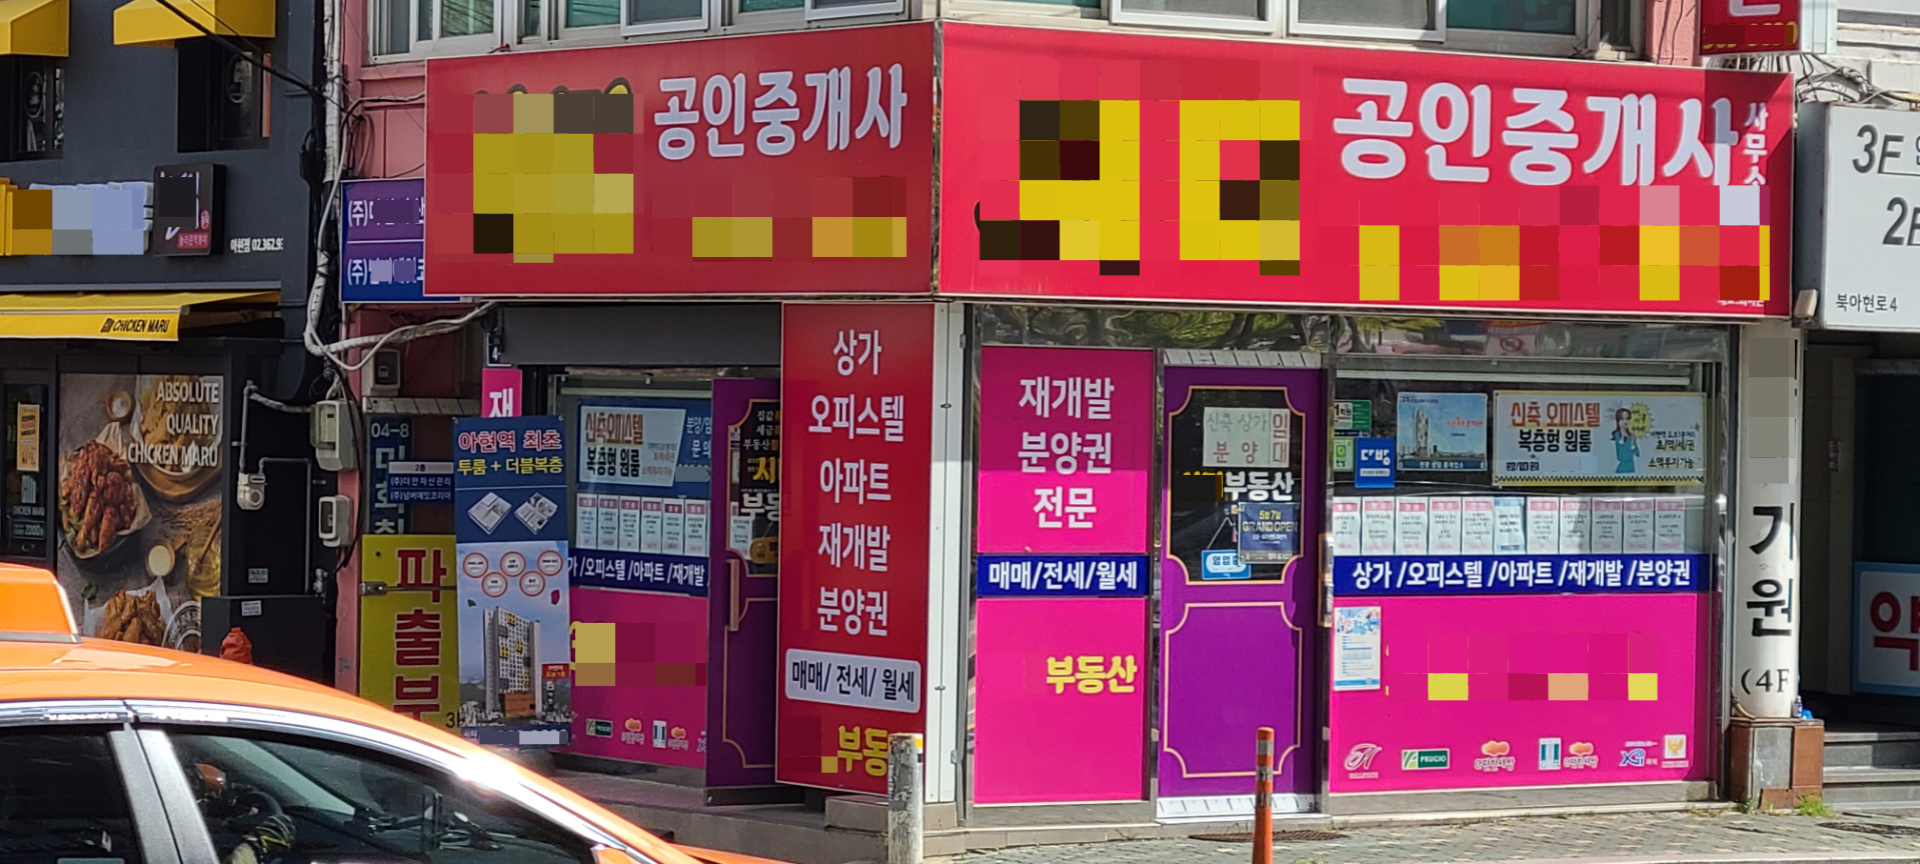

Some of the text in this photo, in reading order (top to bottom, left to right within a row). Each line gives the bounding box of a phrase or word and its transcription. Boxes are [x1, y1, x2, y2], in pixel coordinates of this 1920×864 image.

[653, 63, 908, 160] 공인중개사
[1332, 77, 1739, 186] 공인중개사
[1852, 124, 1904, 174] 3F
[113, 318, 171, 333] CHICKEN MARU
[833, 329, 882, 376] 상가
[156, 381, 219, 403] ABSOLUTE
[489, 388, 513, 418] 재
[1018, 376, 1115, 420] 재개발
[167, 413, 219, 435] QUALITY
[808, 393, 905, 442] 오피스텔
[1206, 412, 1268, 433] 신축 상가
[1511, 402, 1541, 427] 신축
[1546, 402, 1600, 427] 오피스텔
[371, 423, 409, 438] 04-8
[458, 430, 562, 453] 아현역 최초
[1518, 429, 1592, 453] 복층형 원룸
[128, 442, 219, 467] CHICKEN MARU
[457, 458, 487, 476] 투룸
[506, 456, 564, 475] 더블복층
[587, 447, 617, 477] 복층형
[620, 448, 640, 477] 원룸
[1018, 431, 1112, 475] 분양권
[820, 458, 892, 505] 아파트
[1223, 471, 1294, 501] 부동산
[1033, 486, 1097, 529] 전문
[1242, 521, 1273, 532] GRAND
[818, 522, 892, 572] 재개발
[579, 556, 626, 581] /오피스텔
[627, 559, 665, 583] /아파트
[666, 562, 705, 587] /재개발
[988, 561, 1137, 591] 매매/전세/월세
[1352, 559, 1691, 589] 상가 /오피스텔 /아파트 /재개발 /분양권
[817, 586, 889, 637] 분양권
[393, 549, 448, 722] 파출부
[792, 660, 915, 703] 매매/ 전세/ 월세
[1046, 654, 1138, 695] 부동산
[1420, 755, 1447, 763] PRUGIO
